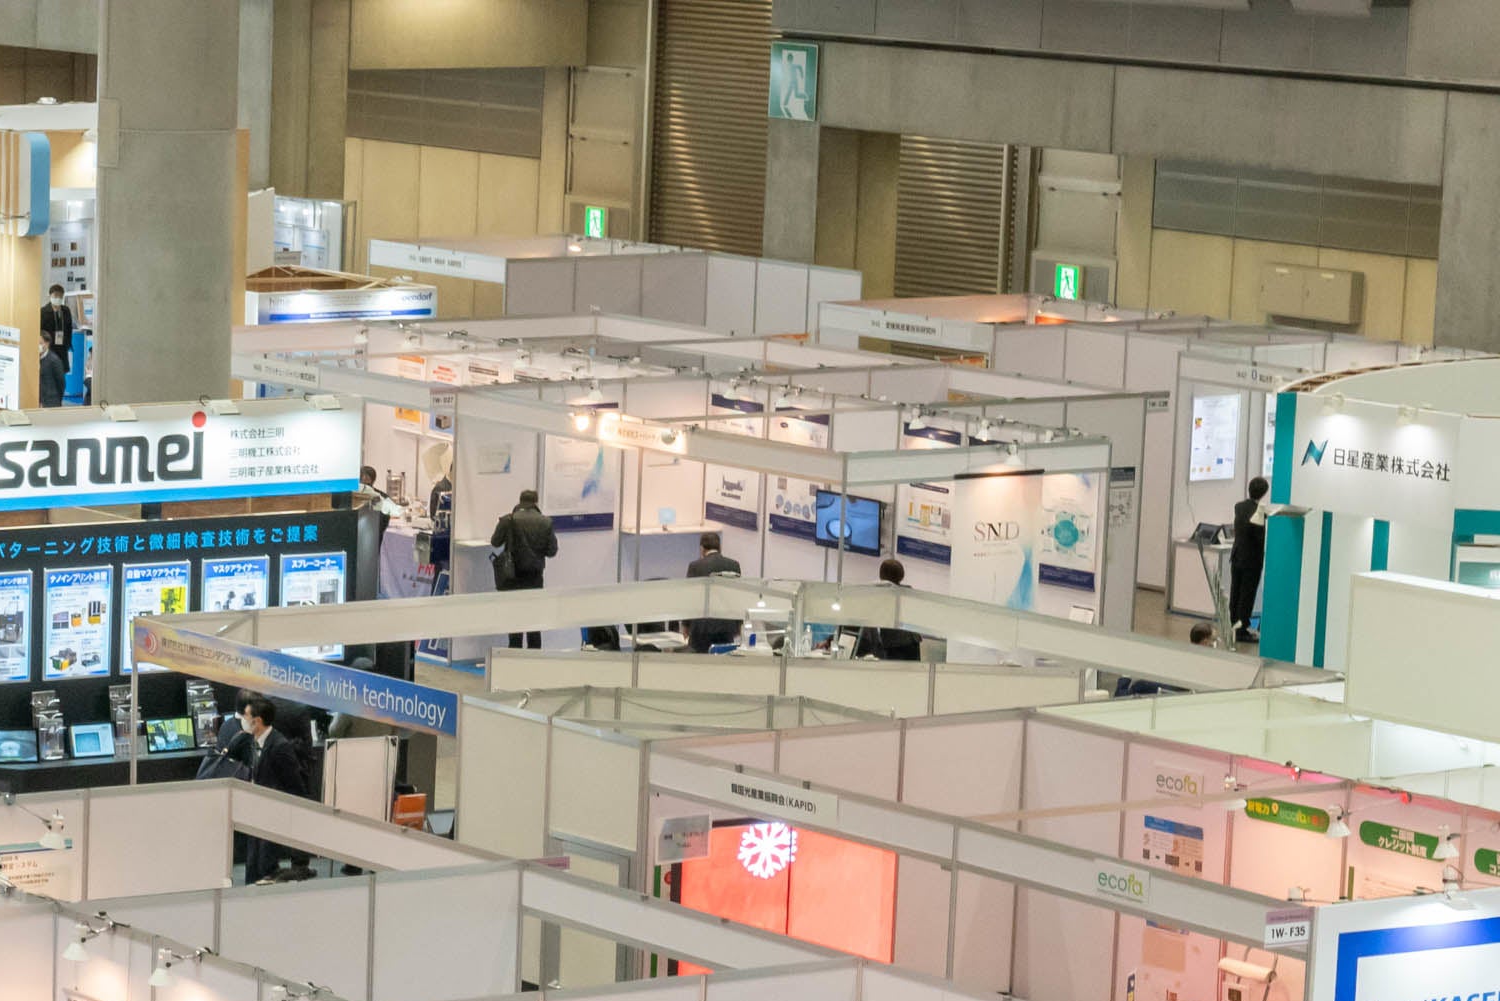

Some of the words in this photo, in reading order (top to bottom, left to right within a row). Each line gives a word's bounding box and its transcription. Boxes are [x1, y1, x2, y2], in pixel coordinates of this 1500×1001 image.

[229, 426, 285, 441] 株式会社三明
[1334, 448, 1451, 482] 日星産業株式会社
[973, 520, 1020, 542] SND
[261, 659, 321, 692] Realized
[325, 679, 358, 702] with
[362, 684, 447, 728] technology
